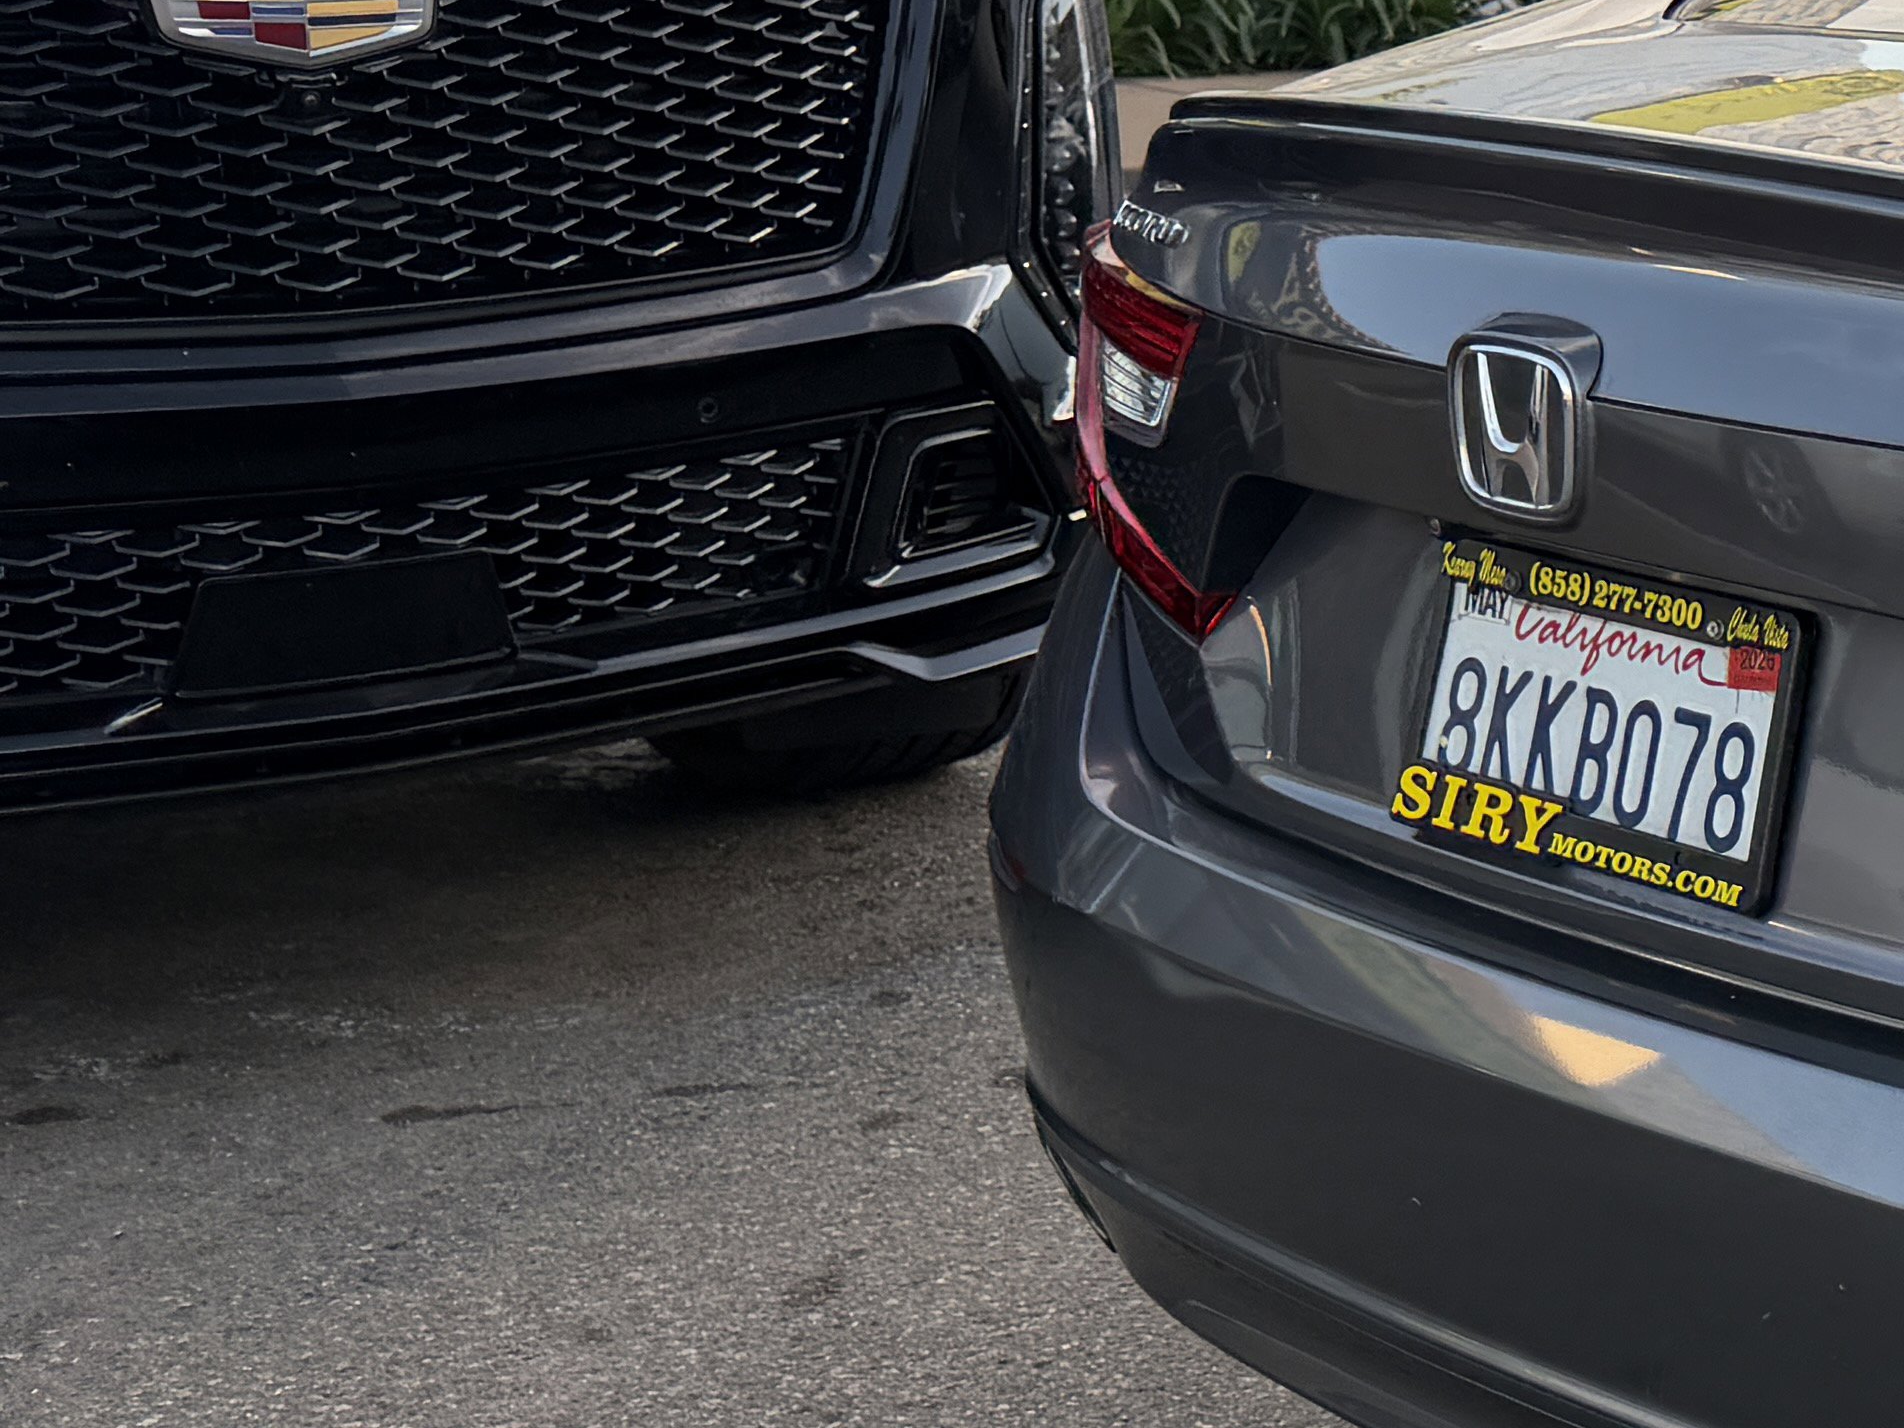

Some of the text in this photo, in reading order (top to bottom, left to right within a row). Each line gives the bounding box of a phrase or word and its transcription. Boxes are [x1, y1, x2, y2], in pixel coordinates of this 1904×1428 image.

[1514, 603, 1727, 687] California
[1529, 561, 1591, 607] (858)
[1593, 580, 1702, 631] 277-7300
[1440, 656, 1756, 854] 8KKB078
[1391, 764, 1744, 908] SIRY MOTORS.COM
